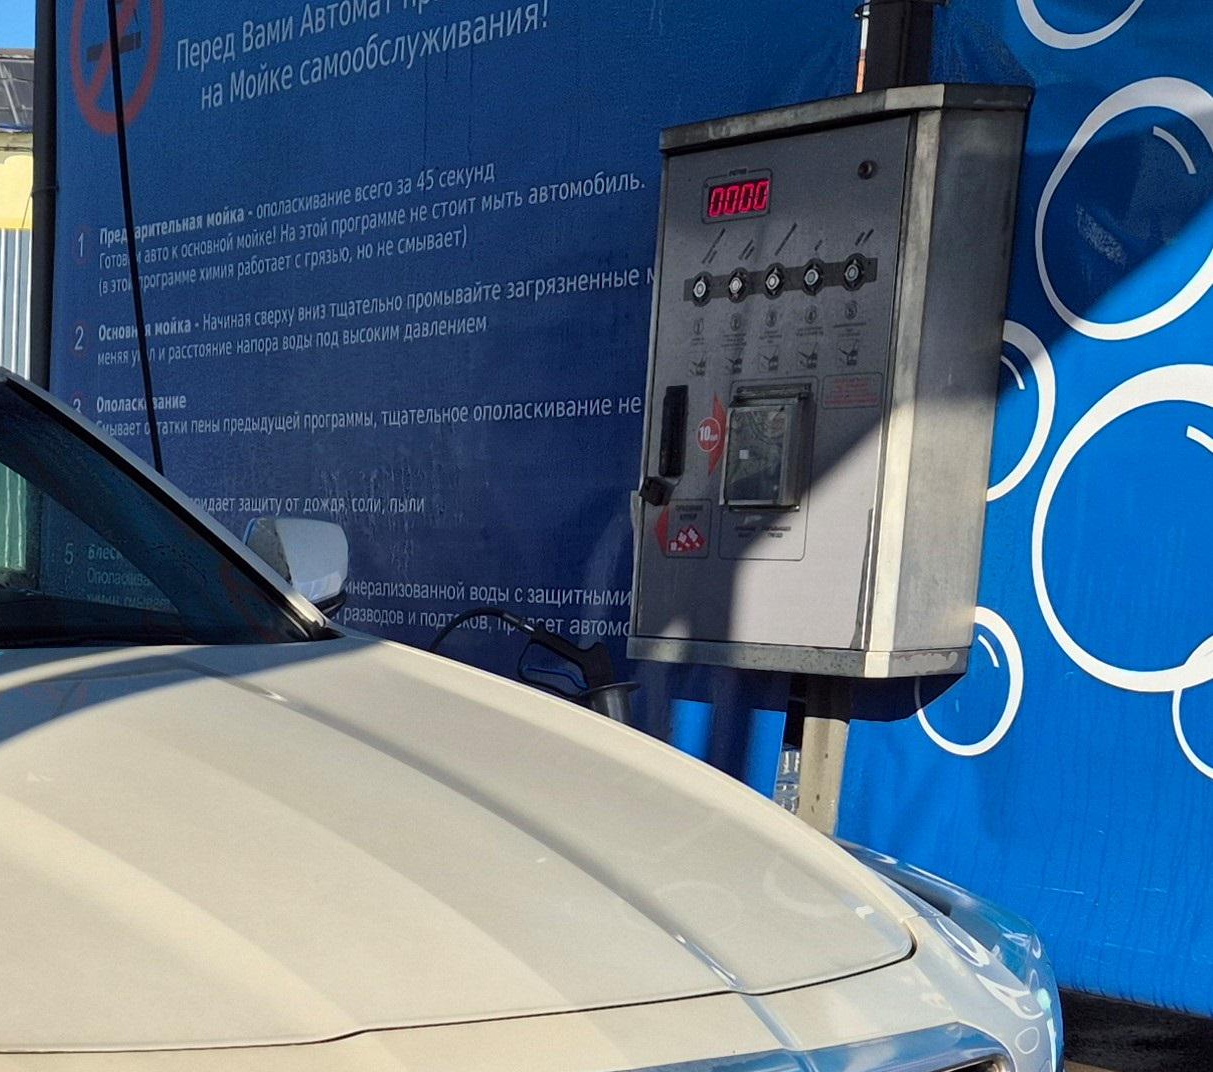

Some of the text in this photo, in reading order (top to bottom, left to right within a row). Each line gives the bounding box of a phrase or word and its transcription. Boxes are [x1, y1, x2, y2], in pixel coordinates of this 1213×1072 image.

[177, 32, 235, 72] Перед
[242, 15, 294, 53] Вами
[201, 1, 548, 110] на Мойке самообслуживания!
[99, 214, 203, 248] Предарительная
[206, 206, 244, 228] мойка
[256, 187, 351, 219] ополаскивание
[354, 180, 393, 203] всего
[397, 177, 412, 195] за
[416, 168, 434, 192] 45
[439, 162, 496, 189] секунд
[144, 245, 169, 264] авто
[171, 244, 179, 259] к
[181, 232, 234, 258] основной
[236, 223, 276, 250] мойке!
[280, 223, 296, 243] На
[299, 217, 328, 241] этой
[331, 208, 405, 239] программе
[410, 204, 428, 223] не
[432, 197, 476, 219] стоит
[481, 191, 523, 212] мыть
[528, 170, 646, 204] автомобиль.
[708, 178, 771, 218] 0000
[77, 232, 85, 258] 1
[199, 262, 234, 282] химия
[237, 253, 291, 280] работает
[294, 253, 302, 269] с
[304, 246, 353, 271] грязью,
[357, 242, 373, 260] но
[377, 239, 394, 256] не
[397, 223, 468, 254] смывает)
[98, 324, 151, 342] Основня
[154, 316, 192, 335] мойка
[203, 312, 252, 332] Начиная
[254, 305, 294, 328] сверху
[298, 303, 326, 322] вниз
[329, 296, 403, 319] тщательно
[406, 281, 502, 313] промывайте
[506, 267, 640, 301] загрязненные
[73, 325, 84, 351] 2
[98, 350, 129, 367] меняя
[159, 348, 166, 362] и
[169, 342, 232, 365] расстояние
[236, 336, 279, 356] напора
[282, 333, 312, 351] воды
[316, 330, 339, 349] под
[343, 324, 400, 345] высоким
[403, 315, 487, 342] давлением
[97, 395, 186, 414] Ополасквание
[144, 419, 188, 436] отатки
[191, 417, 221, 433] пены
[223, 411, 300, 436] предыдущей
[304, 410, 377, 433] программы,
[381, 405, 468, 426] тщательное
[473, 397, 612, 422] ополаскивание
[618, 396, 642, 414] не
[238, 497, 281, 516] защиту
[286, 496, 300, 511] от
[351, 497, 386, 516] соли,
[389, 497, 425, 514] пыли
[470, 584, 509, 605] воды
[514, 586, 524, 603] с
[527, 586, 632, 608] защитными
[343, 606, 405, 627] разводов
[408, 610, 417, 624] и
